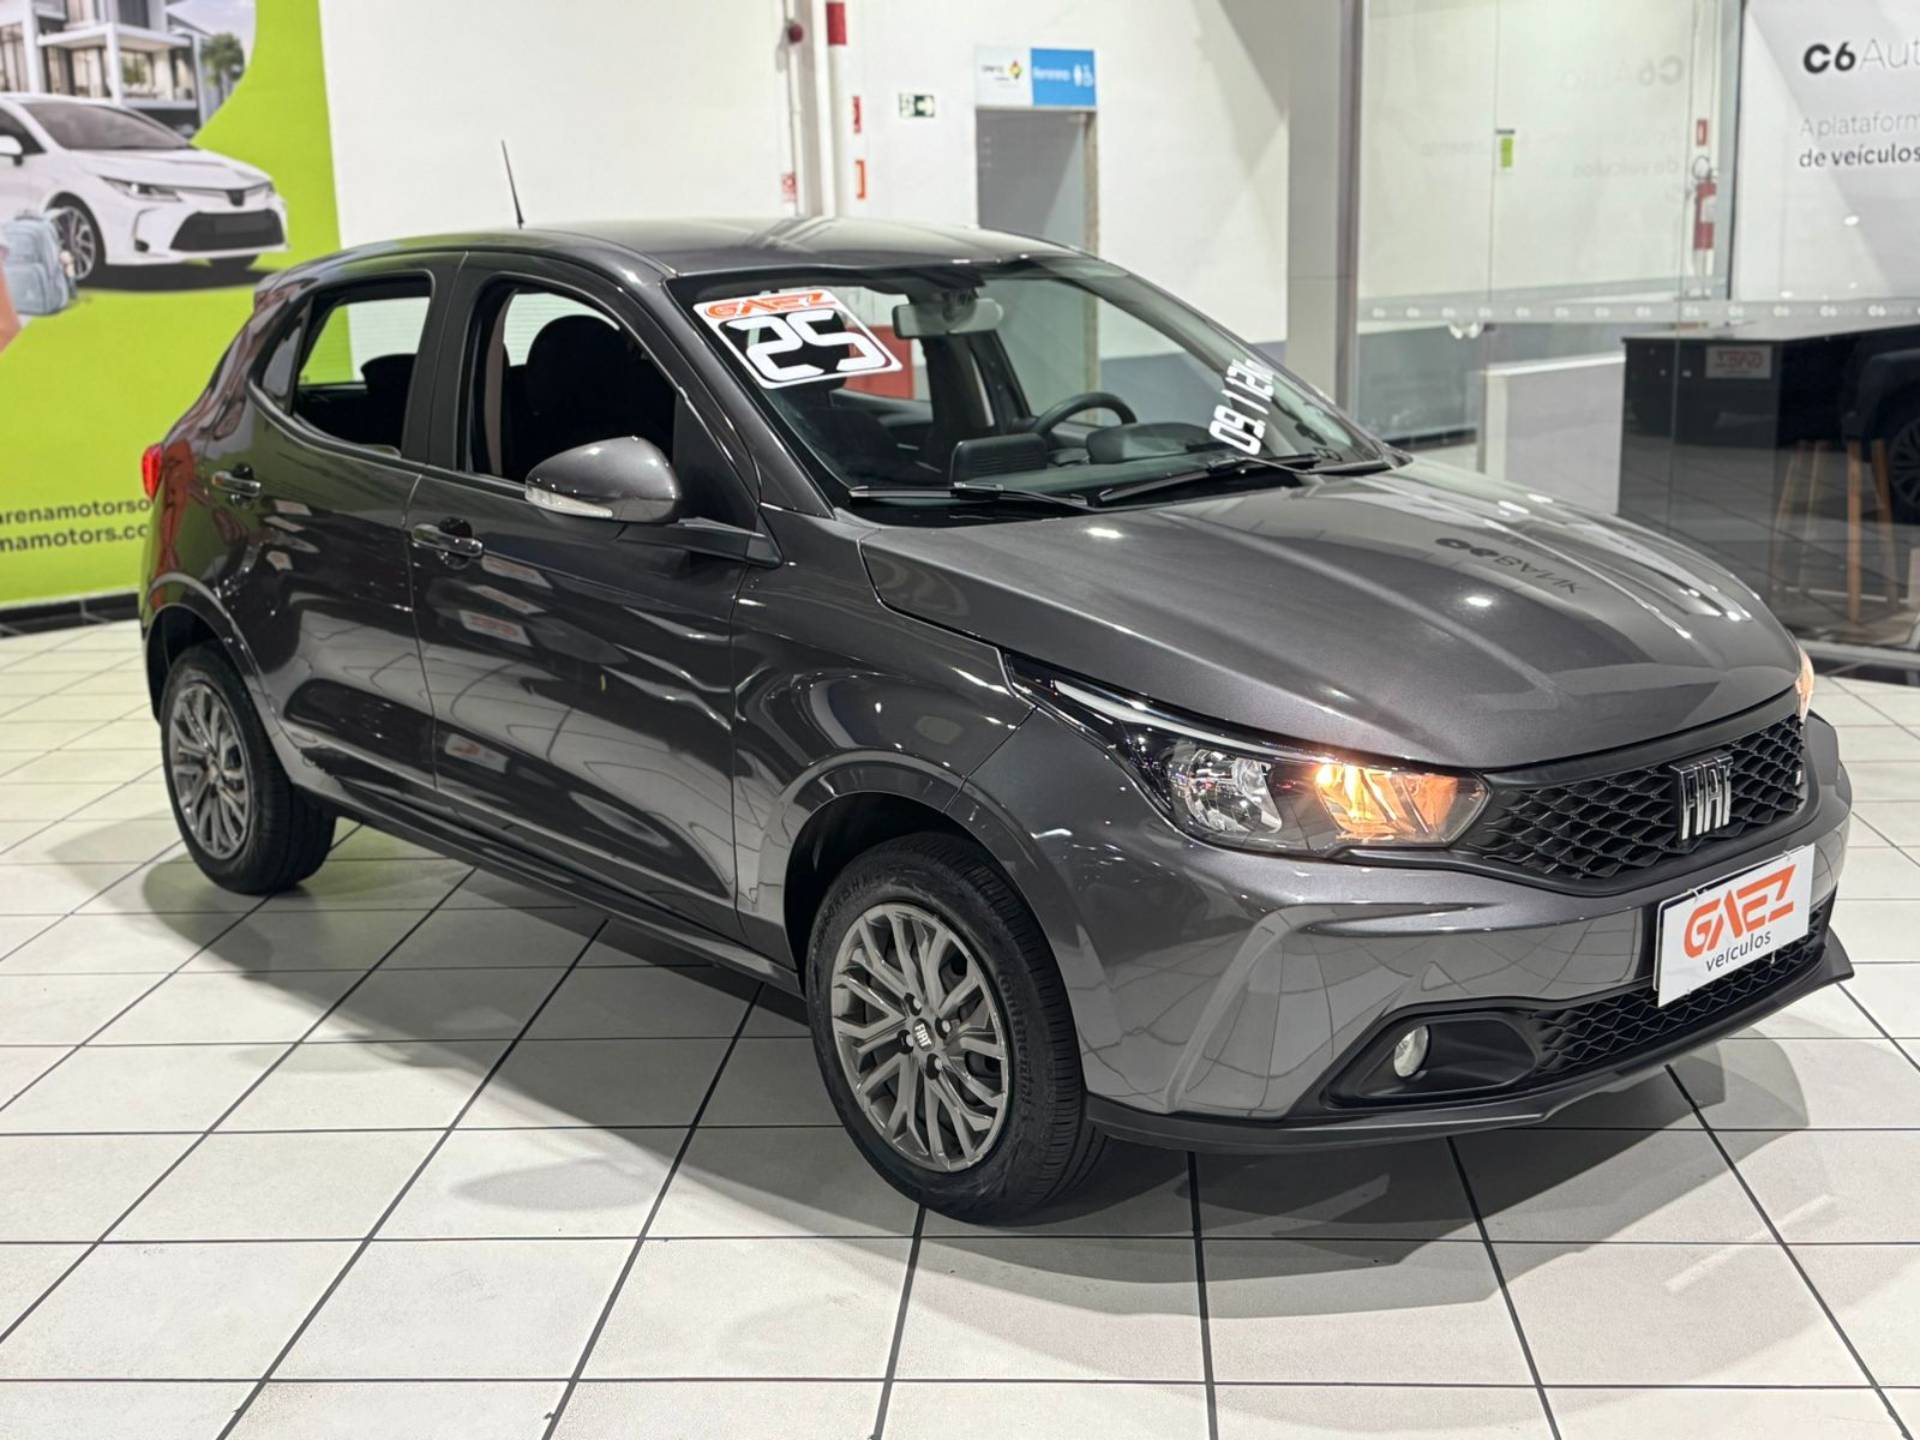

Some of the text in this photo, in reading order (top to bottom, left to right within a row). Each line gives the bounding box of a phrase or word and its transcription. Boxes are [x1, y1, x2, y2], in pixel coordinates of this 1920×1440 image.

[1799, 147, 1826, 167] de
[725, 309, 886, 382] 25
[1679, 756, 1734, 840] FIAT
[1683, 863, 1797, 958] GAEZ
[914, 1023, 932, 1047] FIAT
